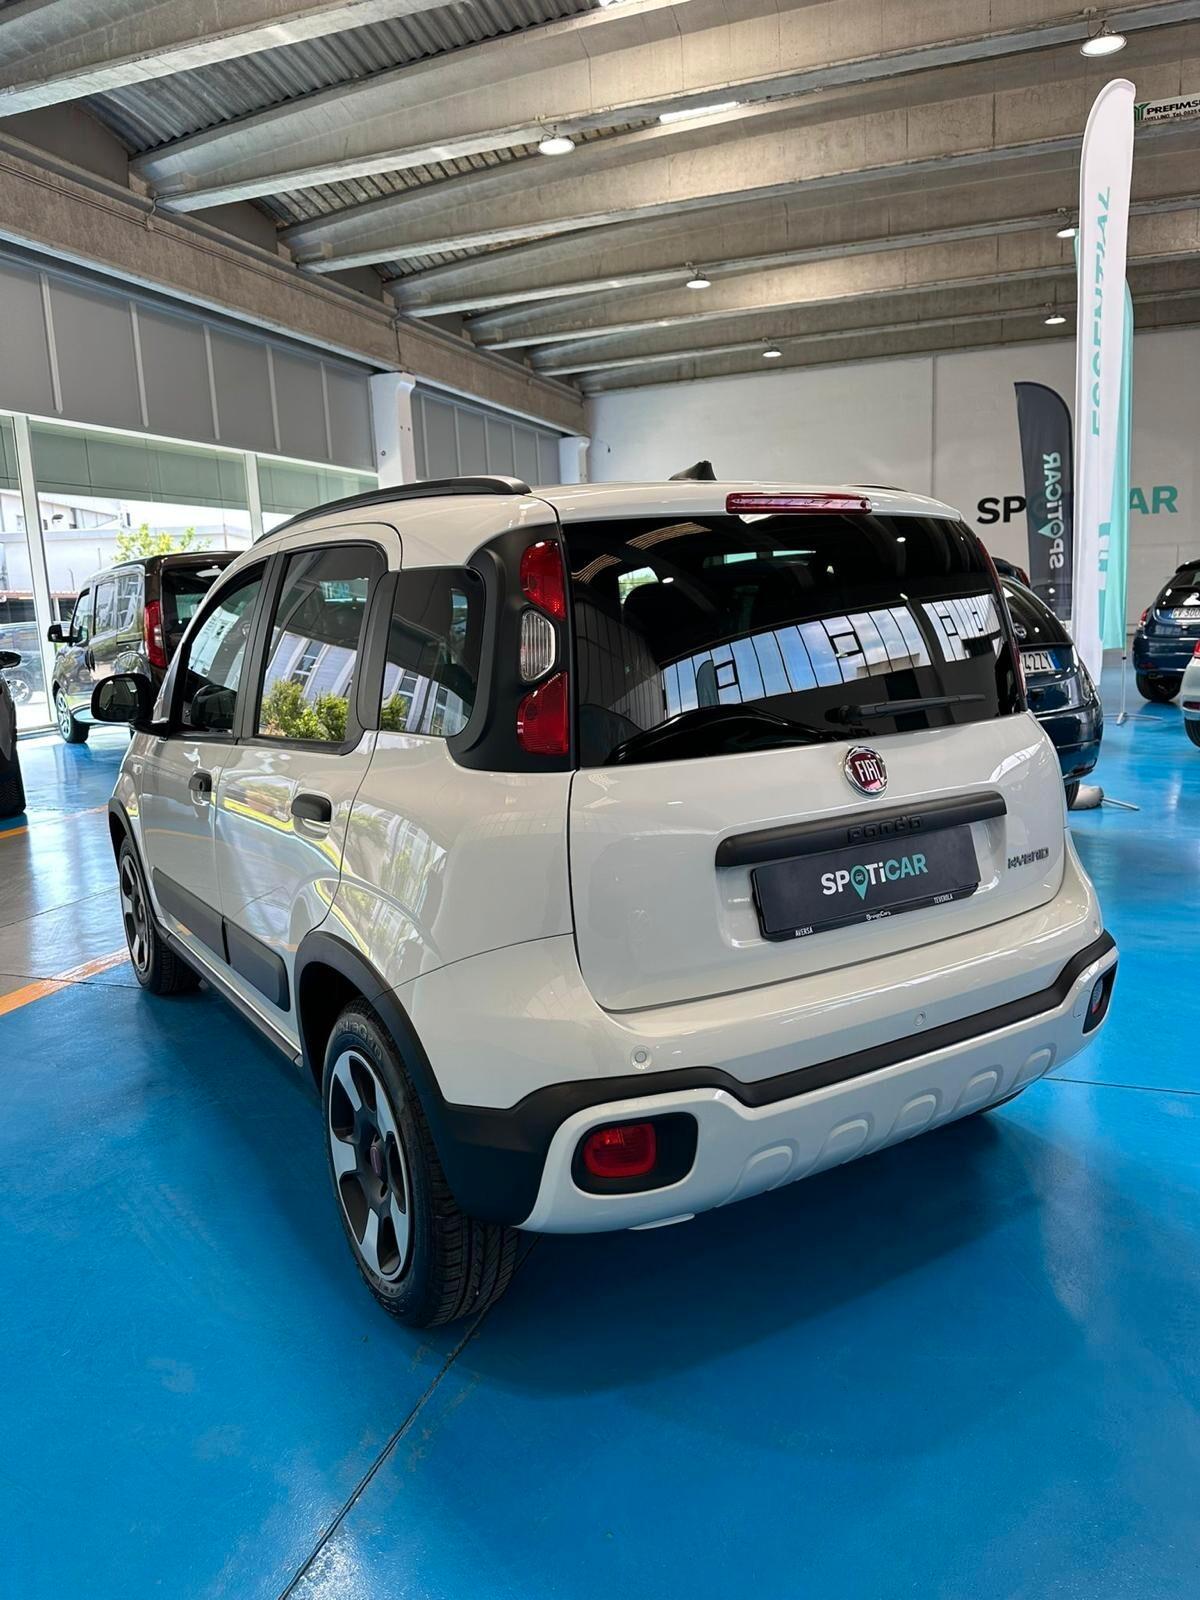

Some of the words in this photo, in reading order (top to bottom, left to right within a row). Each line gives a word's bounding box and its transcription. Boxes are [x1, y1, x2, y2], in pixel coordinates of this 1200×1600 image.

[1146, 100, 1200, 115] PREFIMS
[854, 759, 882, 782] FIAT
[1007, 847, 1049, 869] HYBRID
[795, 926, 814, 937] AVERSA
